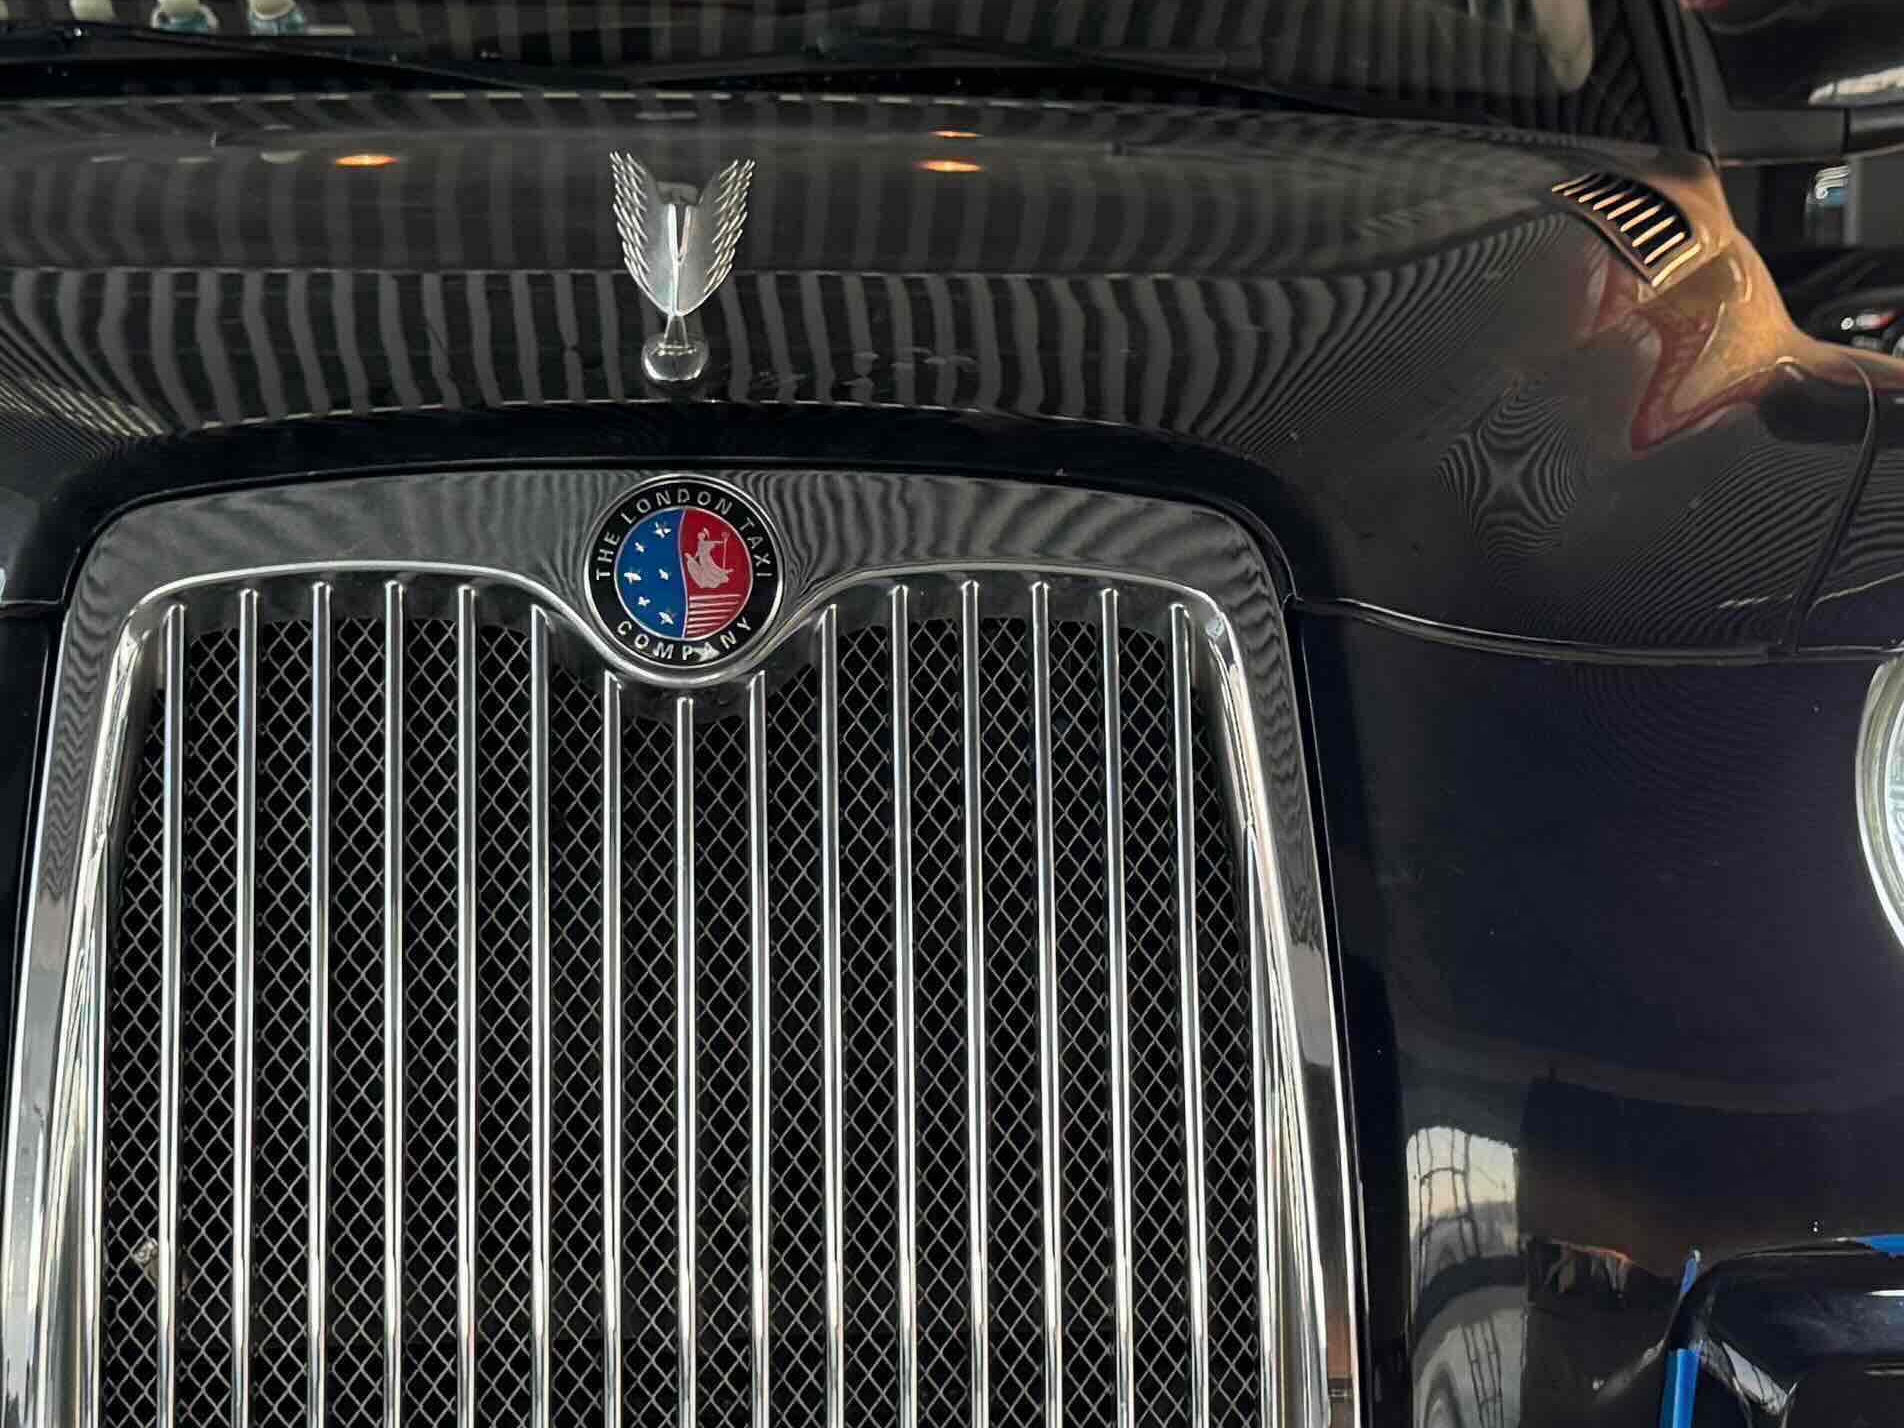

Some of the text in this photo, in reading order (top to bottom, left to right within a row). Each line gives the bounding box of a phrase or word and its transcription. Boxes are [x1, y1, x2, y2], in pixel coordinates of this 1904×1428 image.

[595, 487, 773, 581] THE LONDON TAXI
[616, 616, 753, 662] COMPANY
